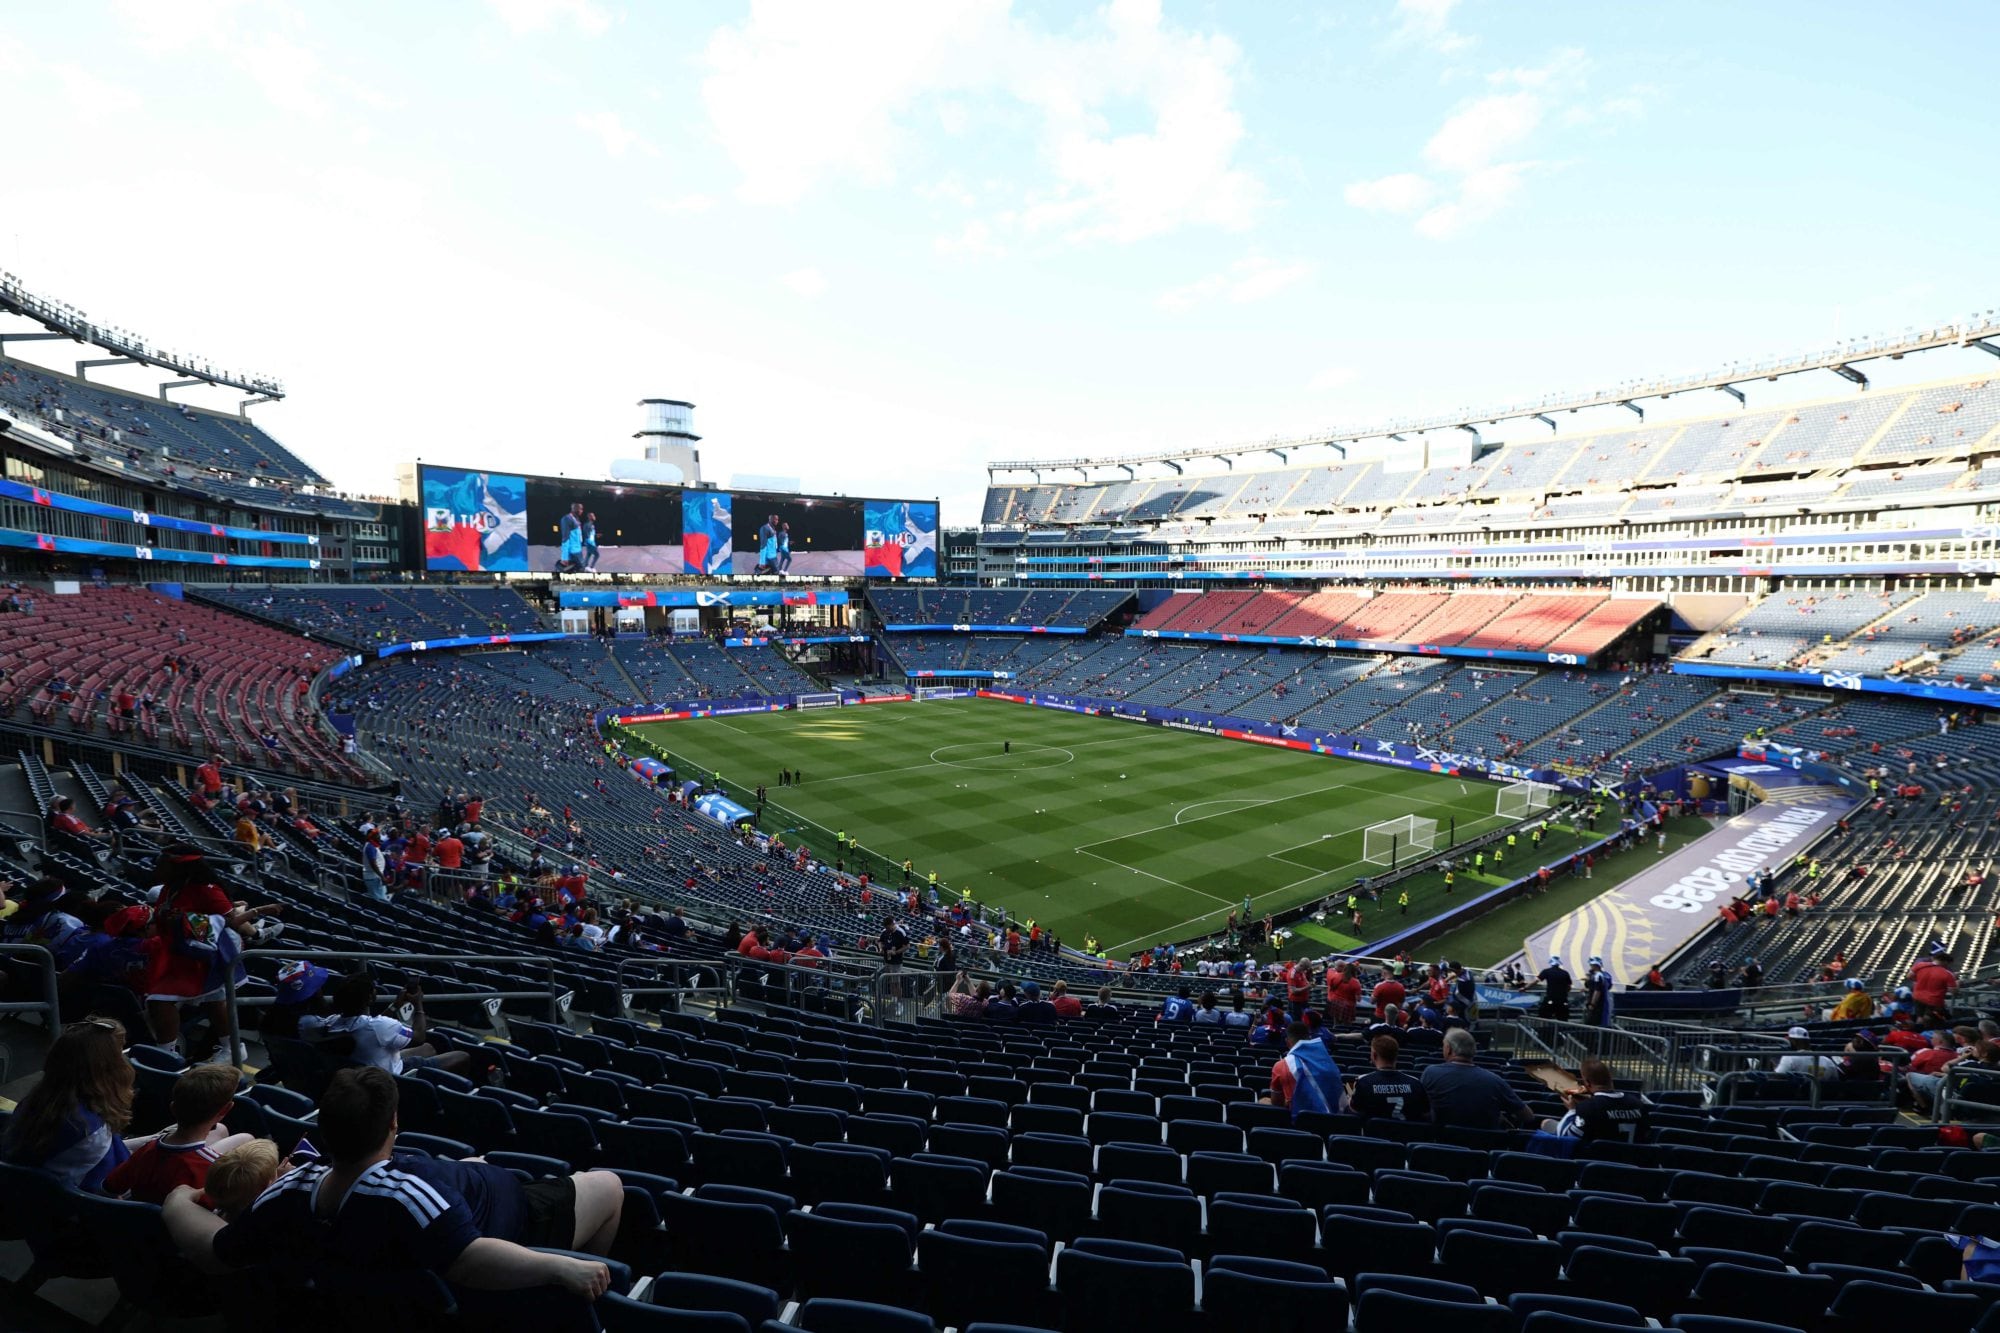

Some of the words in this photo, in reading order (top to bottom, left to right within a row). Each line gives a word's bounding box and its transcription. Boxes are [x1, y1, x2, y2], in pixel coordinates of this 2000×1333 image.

[1200, 726, 1215, 734] AMERICA
[1773, 807, 1828, 825] FIFA
[1737, 822, 1809, 853] WORLD
[1711, 848, 1768, 873] CUP
[1650, 866, 1742, 914] 2026
[403, 1004, 412, 1014] 14
[490, 1001, 499, 1010] 13
[1168, 1002, 1180, 1020] 9
[1372, 1084, 1412, 1094] ROBERTSON
[1605, 1108, 1642, 1119] MCGINN
[1618, 1123, 1637, 1144] 7
